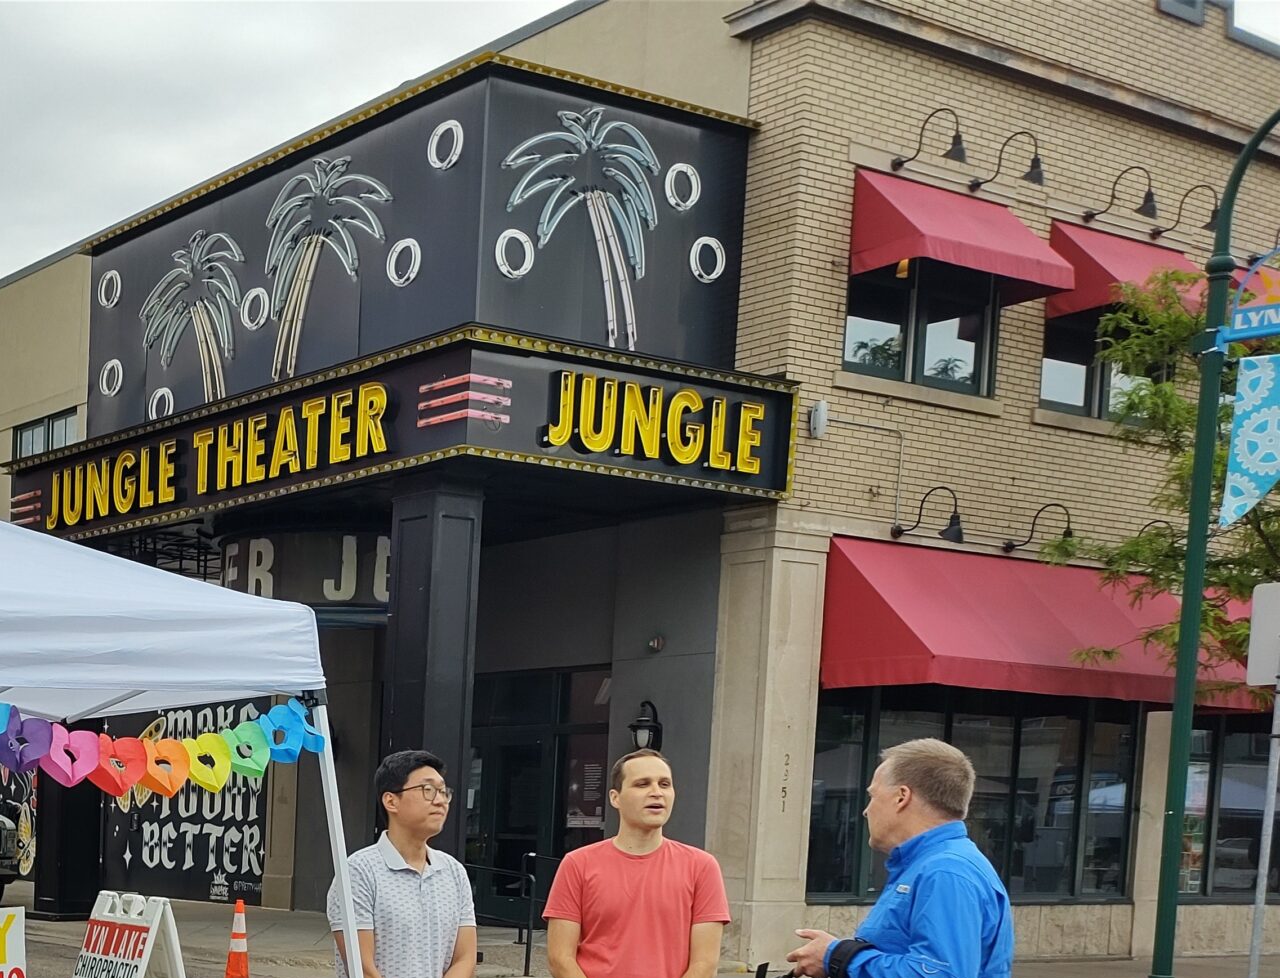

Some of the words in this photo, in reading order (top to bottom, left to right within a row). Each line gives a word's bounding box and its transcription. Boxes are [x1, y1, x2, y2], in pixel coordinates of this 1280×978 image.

[46, 438, 176, 532] JUNGLE
[193, 381, 389, 496] THEATER
[546, 369, 764, 476] JUNGLE
[141, 820, 263, 876] BETTER
[83, 923, 110, 957] LYN
[110, 929, 149, 961] LAKE
